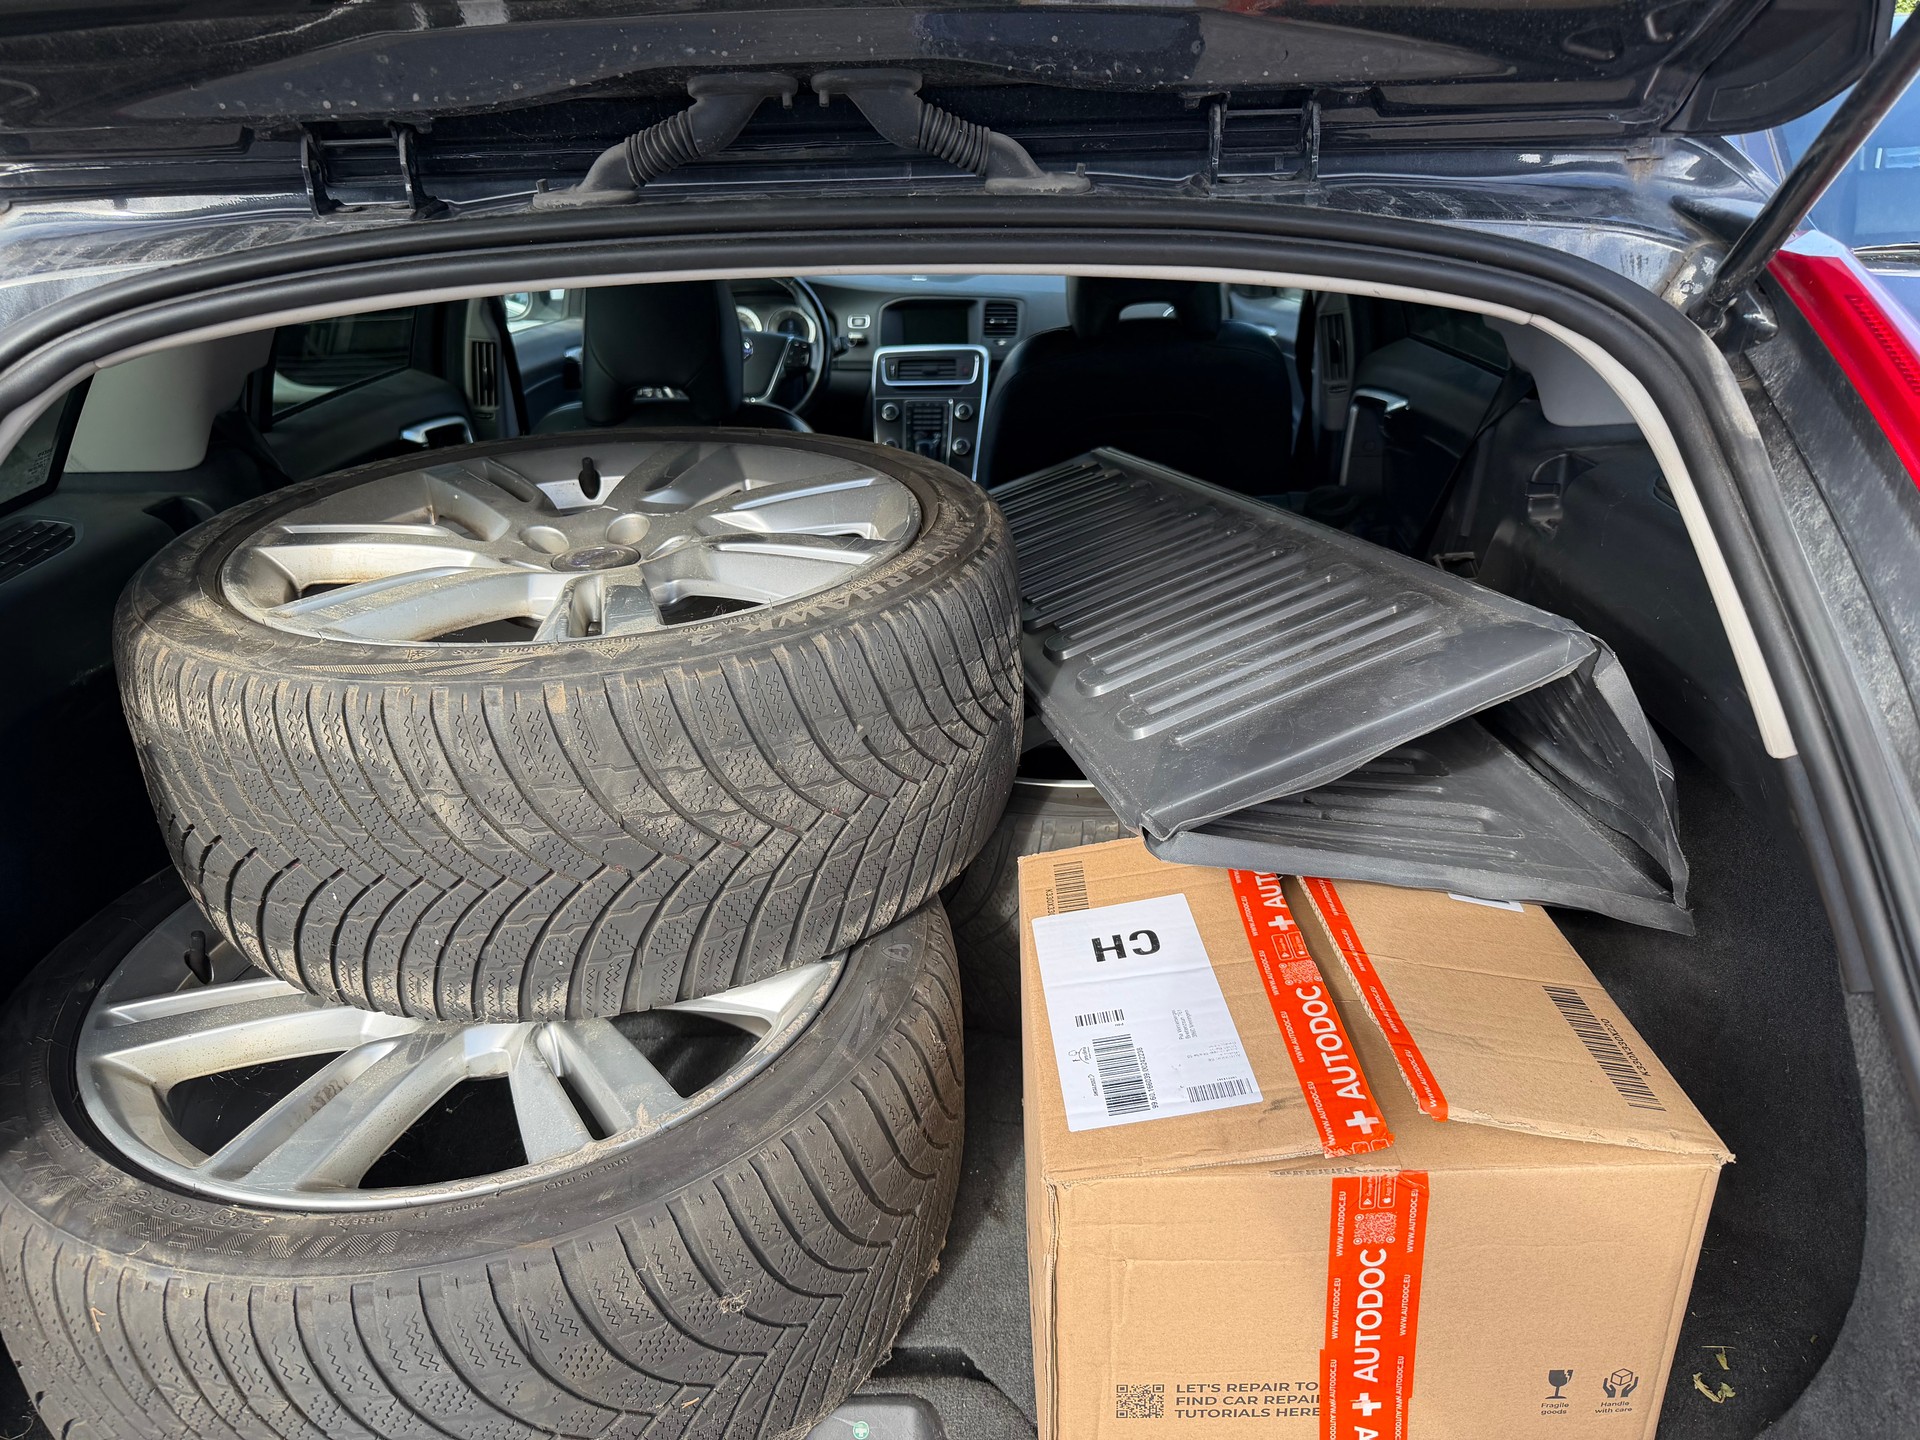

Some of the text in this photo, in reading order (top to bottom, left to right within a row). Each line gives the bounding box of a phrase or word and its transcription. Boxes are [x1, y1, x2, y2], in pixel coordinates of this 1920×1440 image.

[1241, 895, 1258, 937] WWW.AUTODOC.EU
[1091, 929, 1161, 962] CH
[1258, 949, 1280, 996] WWW.AUTODOC.EU
[1340, 928, 1366, 973] WWW.AUTODOC.EU
[1370, 985, 1399, 1034] WWW.AUTODOC.EU
[1280, 1010, 1305, 1064] WWW.AUTODOC.EU
[1296, 985, 1367, 1101] AUTODOC
[1600, 1016, 1651, 1078] K330X330X220
[1404, 1048, 1438, 1108] WWW.AUTODOC.EU
[1306, 1081, 1337, 1146] WWW.AUTODOC.EU
[1336, 1190, 1347, 1257] WWW.AUTODOC.EU
[1406, 1188, 1419, 1254] WWW.AUTODOC.EU
[1331, 1277, 1342, 1341] WWW.AUTODOC.EU
[1353, 1248, 1388, 1384] AUTODOC
[1399, 1273, 1412, 1337] WWW.AUTODOC.EU
[1174, 1408, 1271, 1420] TUTORIALS
[1175, 1383, 1221, 1394] LET'S
[1226, 1382, 1289, 1393] REPAIR
[1175, 1396, 1218, 1407] FIND
[1222, 1395, 1259, 1406] CAR
[1541, 1402, 1570, 1410] Fragile
